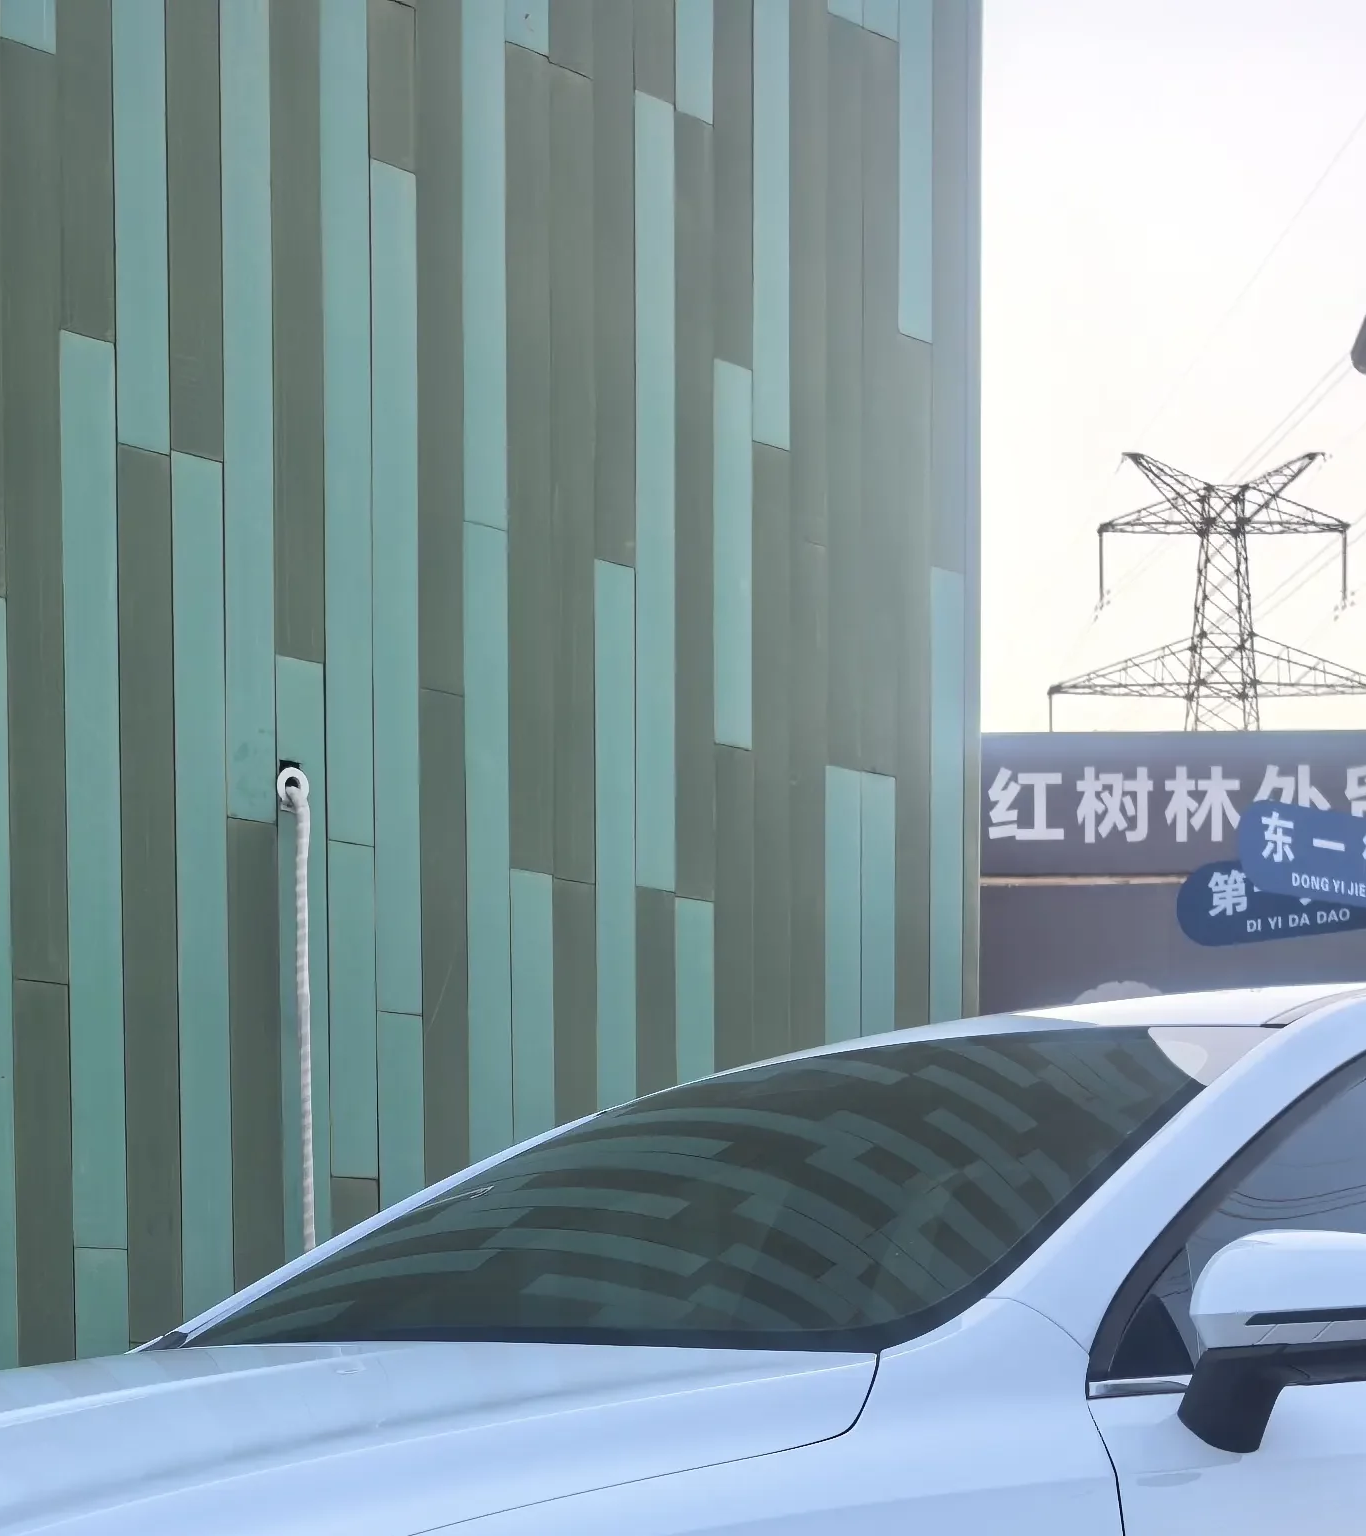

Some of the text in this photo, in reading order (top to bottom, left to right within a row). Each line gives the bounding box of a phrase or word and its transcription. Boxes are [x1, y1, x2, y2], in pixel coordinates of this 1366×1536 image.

[1291, 872, 1366, 898] DONG YI JIE
[1246, 908, 1351, 933] DI YI DA DAO
